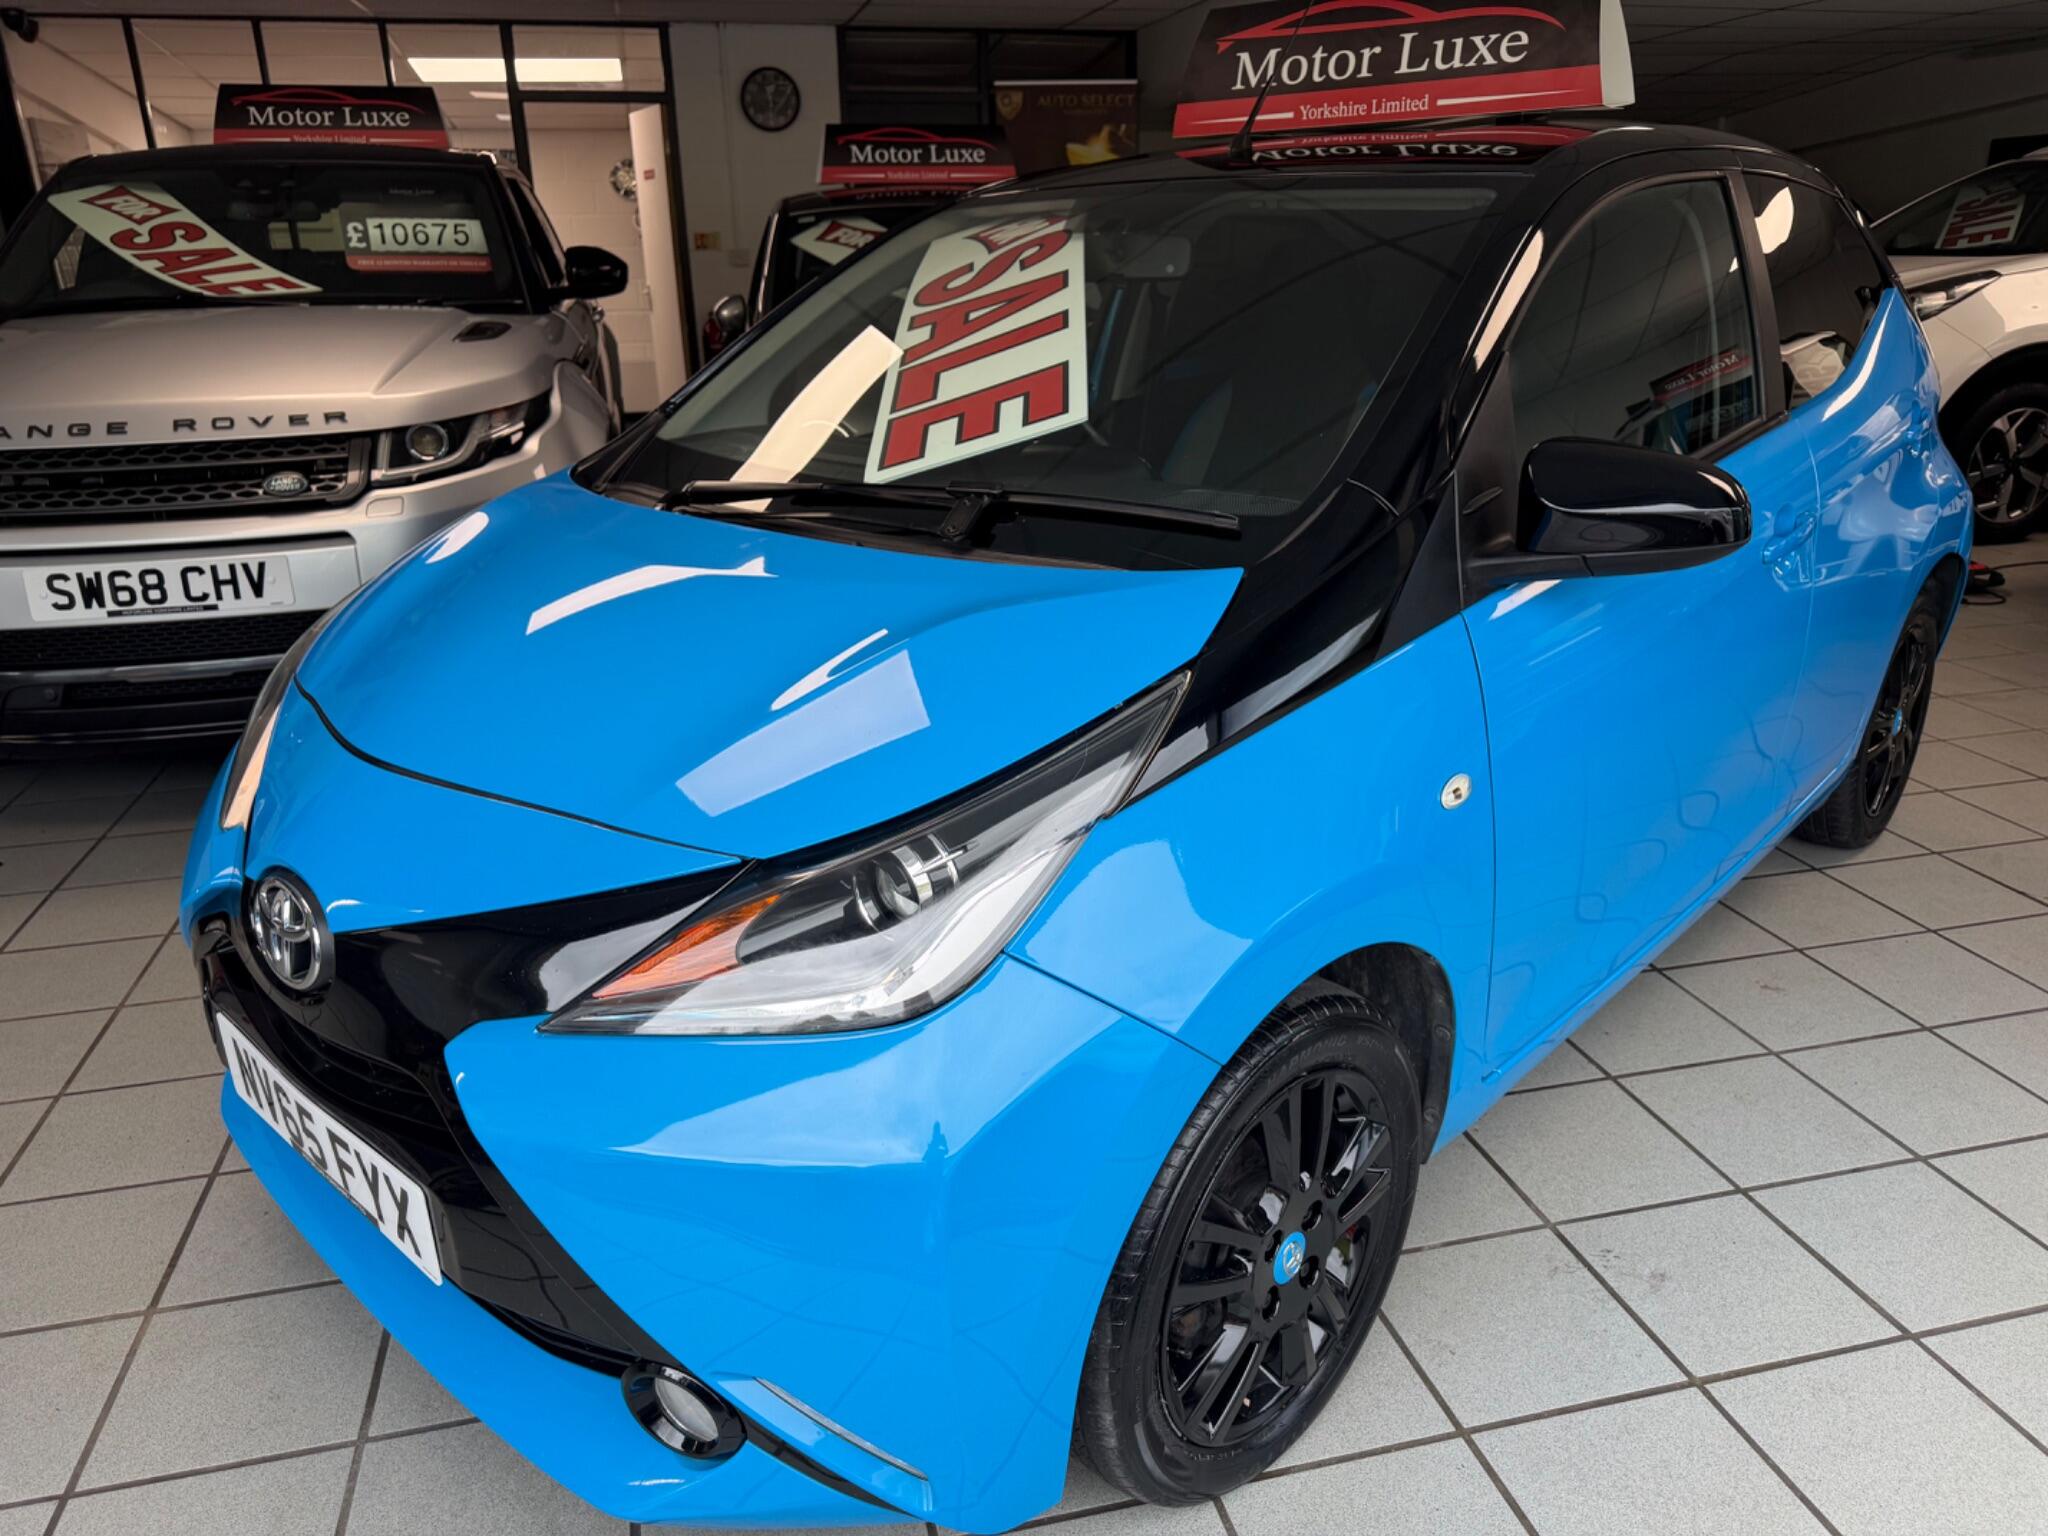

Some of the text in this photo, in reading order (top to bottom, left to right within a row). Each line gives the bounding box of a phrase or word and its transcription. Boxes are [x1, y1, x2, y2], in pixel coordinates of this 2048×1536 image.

[1231, 29, 1530, 91] Motor Luxe
[1037, 94, 1135, 107] AUTO SELECT
[1299, 95, 1429, 121] Yorkshire Limited
[247, 106, 411, 127] Motor Luxe
[850, 144, 986, 163] Motor Luxe
[94, 197, 162, 219] FOR
[110, 221, 306, 296] SALE
[877, 229, 1072, 471] SALE
[172, 411, 348, 433] ROVER
[46, 561, 266, 611] SW68 CHV
[232, 1037, 422, 1259] NV65 FYX
